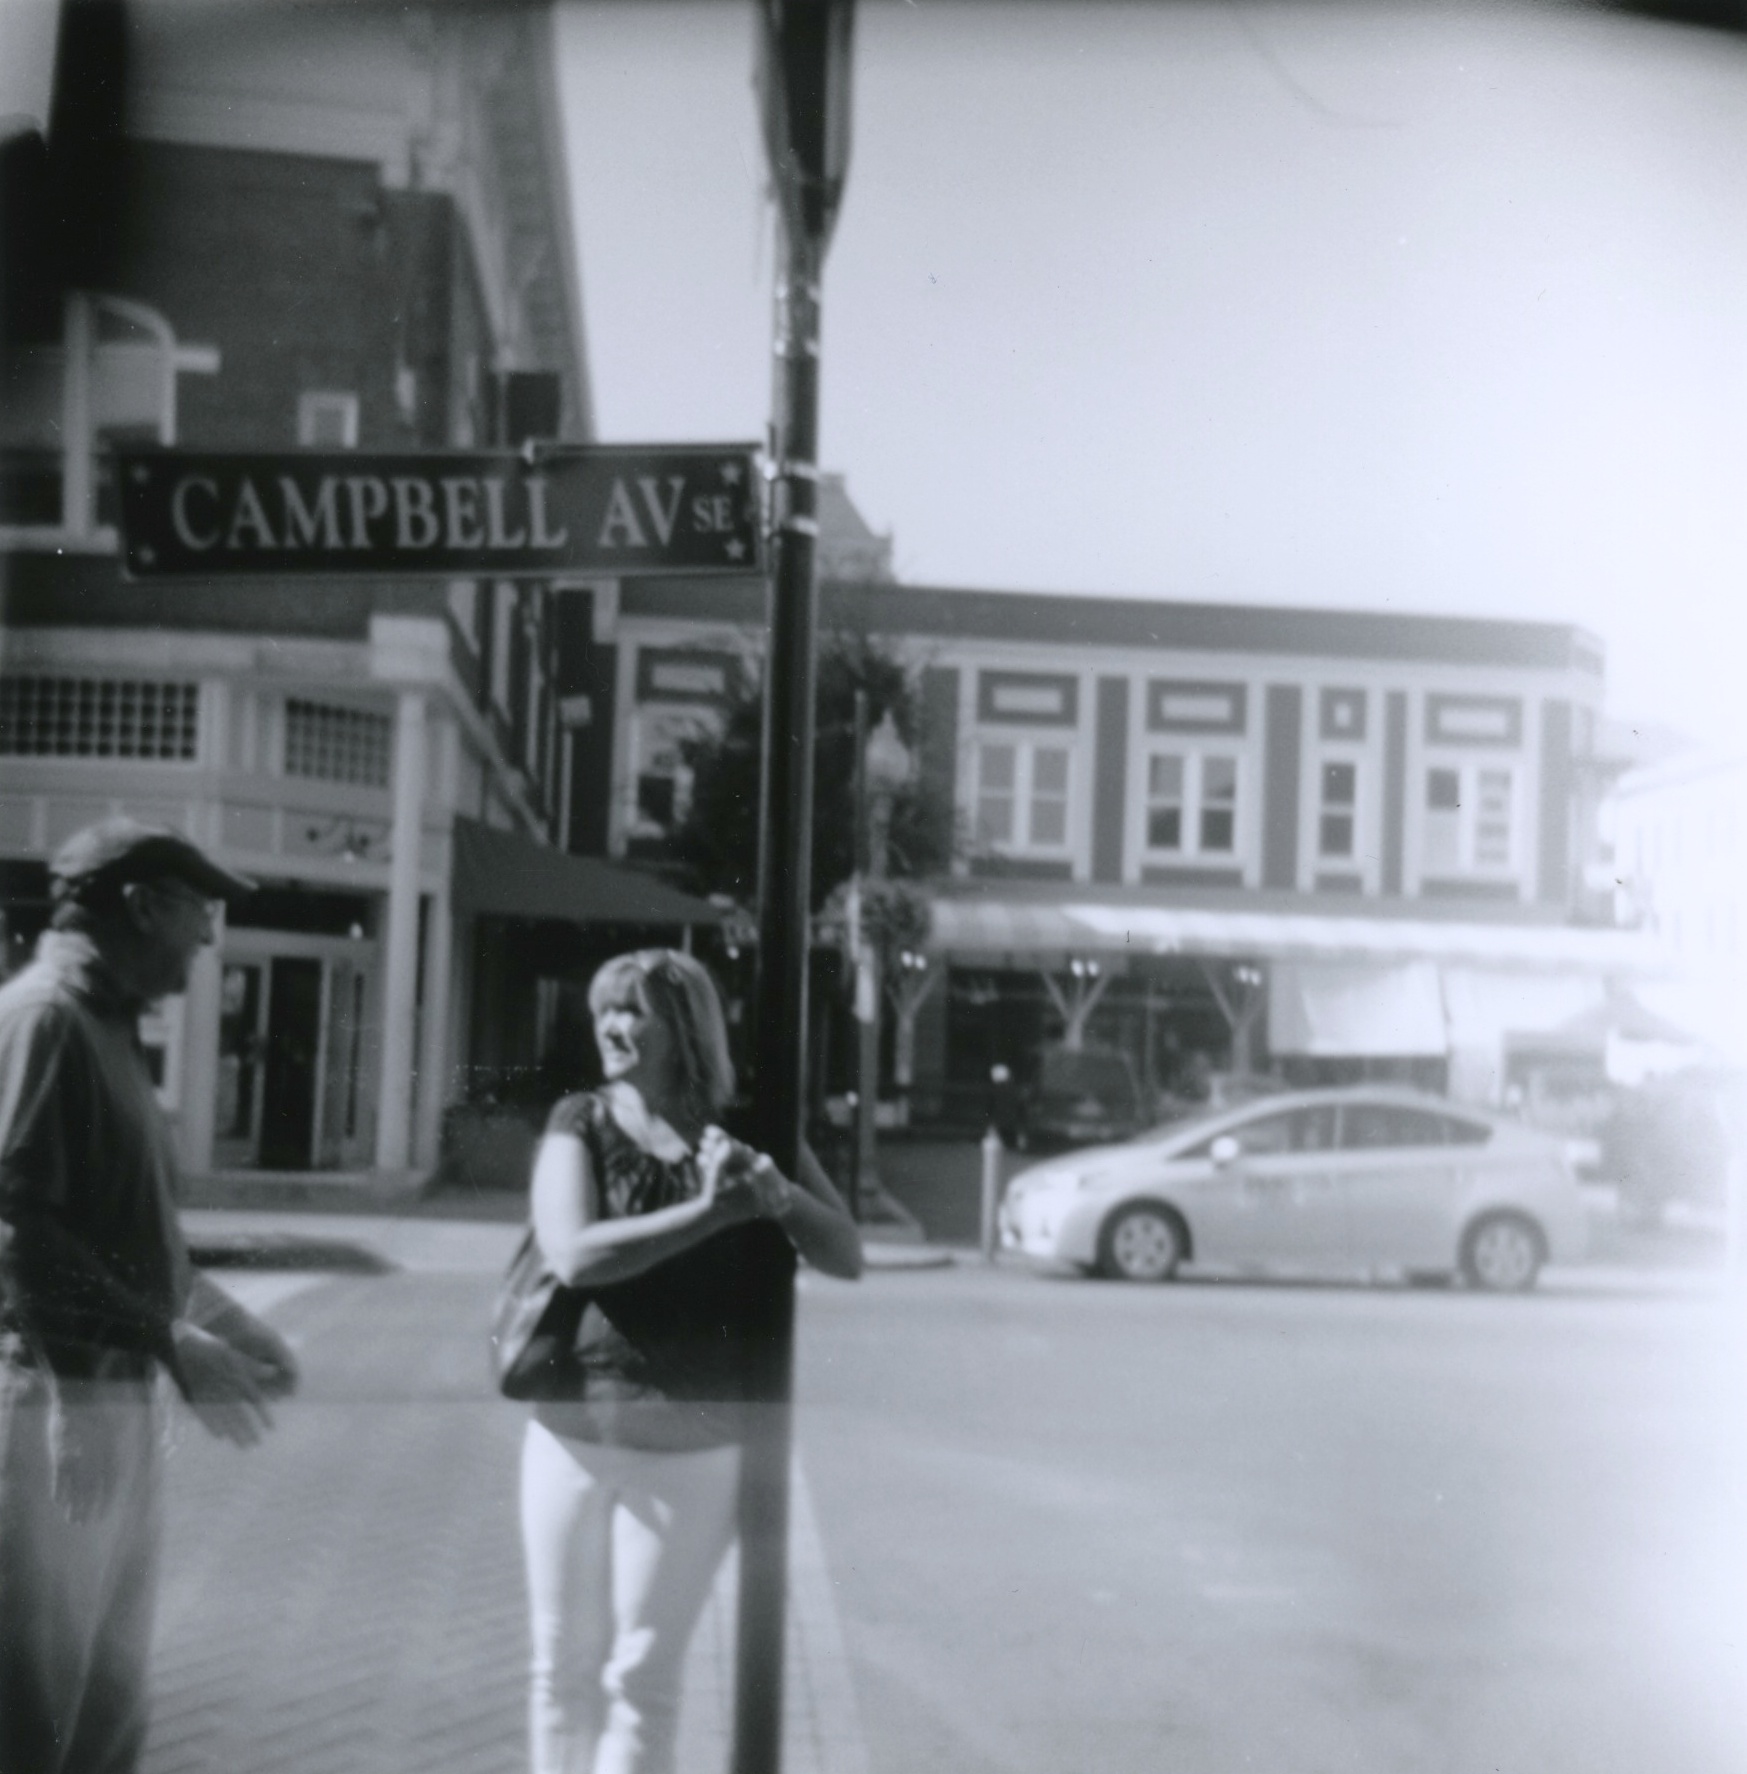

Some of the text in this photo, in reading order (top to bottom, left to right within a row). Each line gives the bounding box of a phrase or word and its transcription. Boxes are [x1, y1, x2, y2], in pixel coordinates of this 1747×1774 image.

[171, 476, 733, 549] CAMPBELL AV SE
